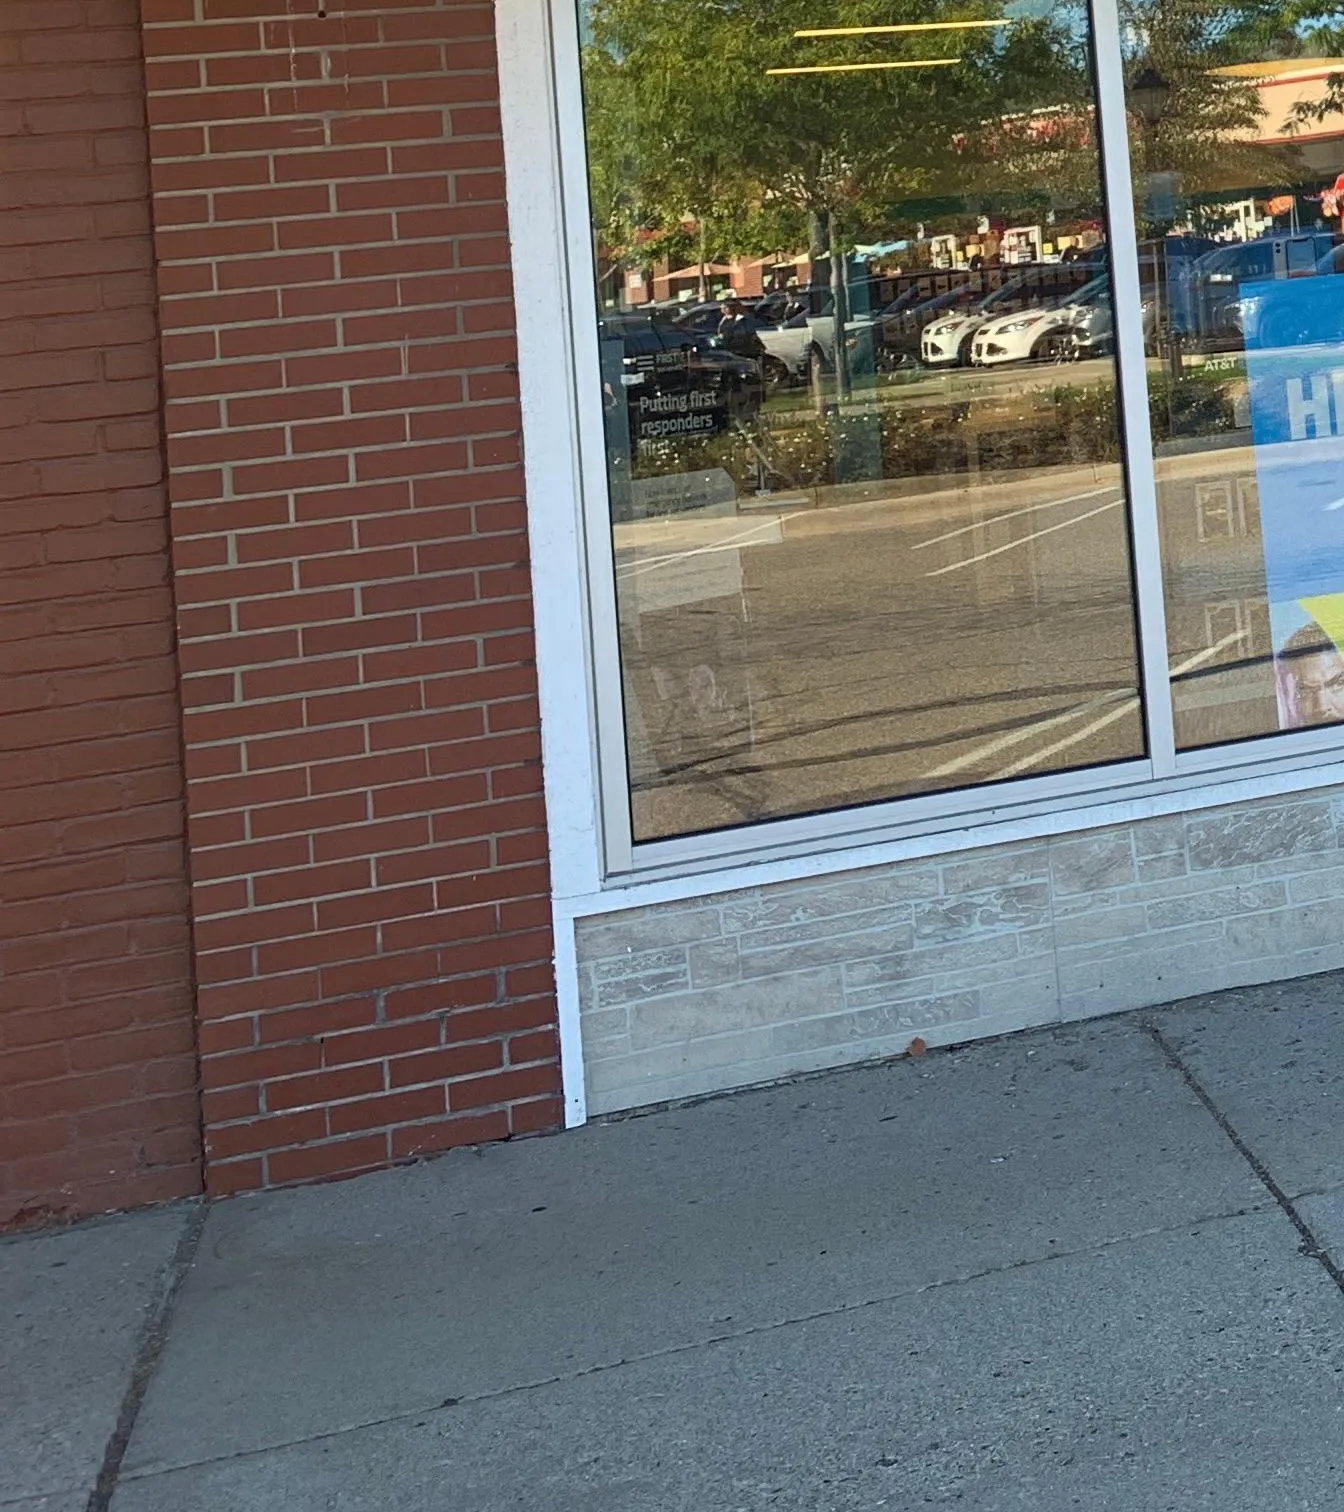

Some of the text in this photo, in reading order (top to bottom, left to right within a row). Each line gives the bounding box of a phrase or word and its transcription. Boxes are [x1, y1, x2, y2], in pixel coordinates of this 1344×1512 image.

[1204, 357, 1238, 373] AT&T
[640, 390, 717, 414] Putting first
[641, 412, 714, 437] responders
